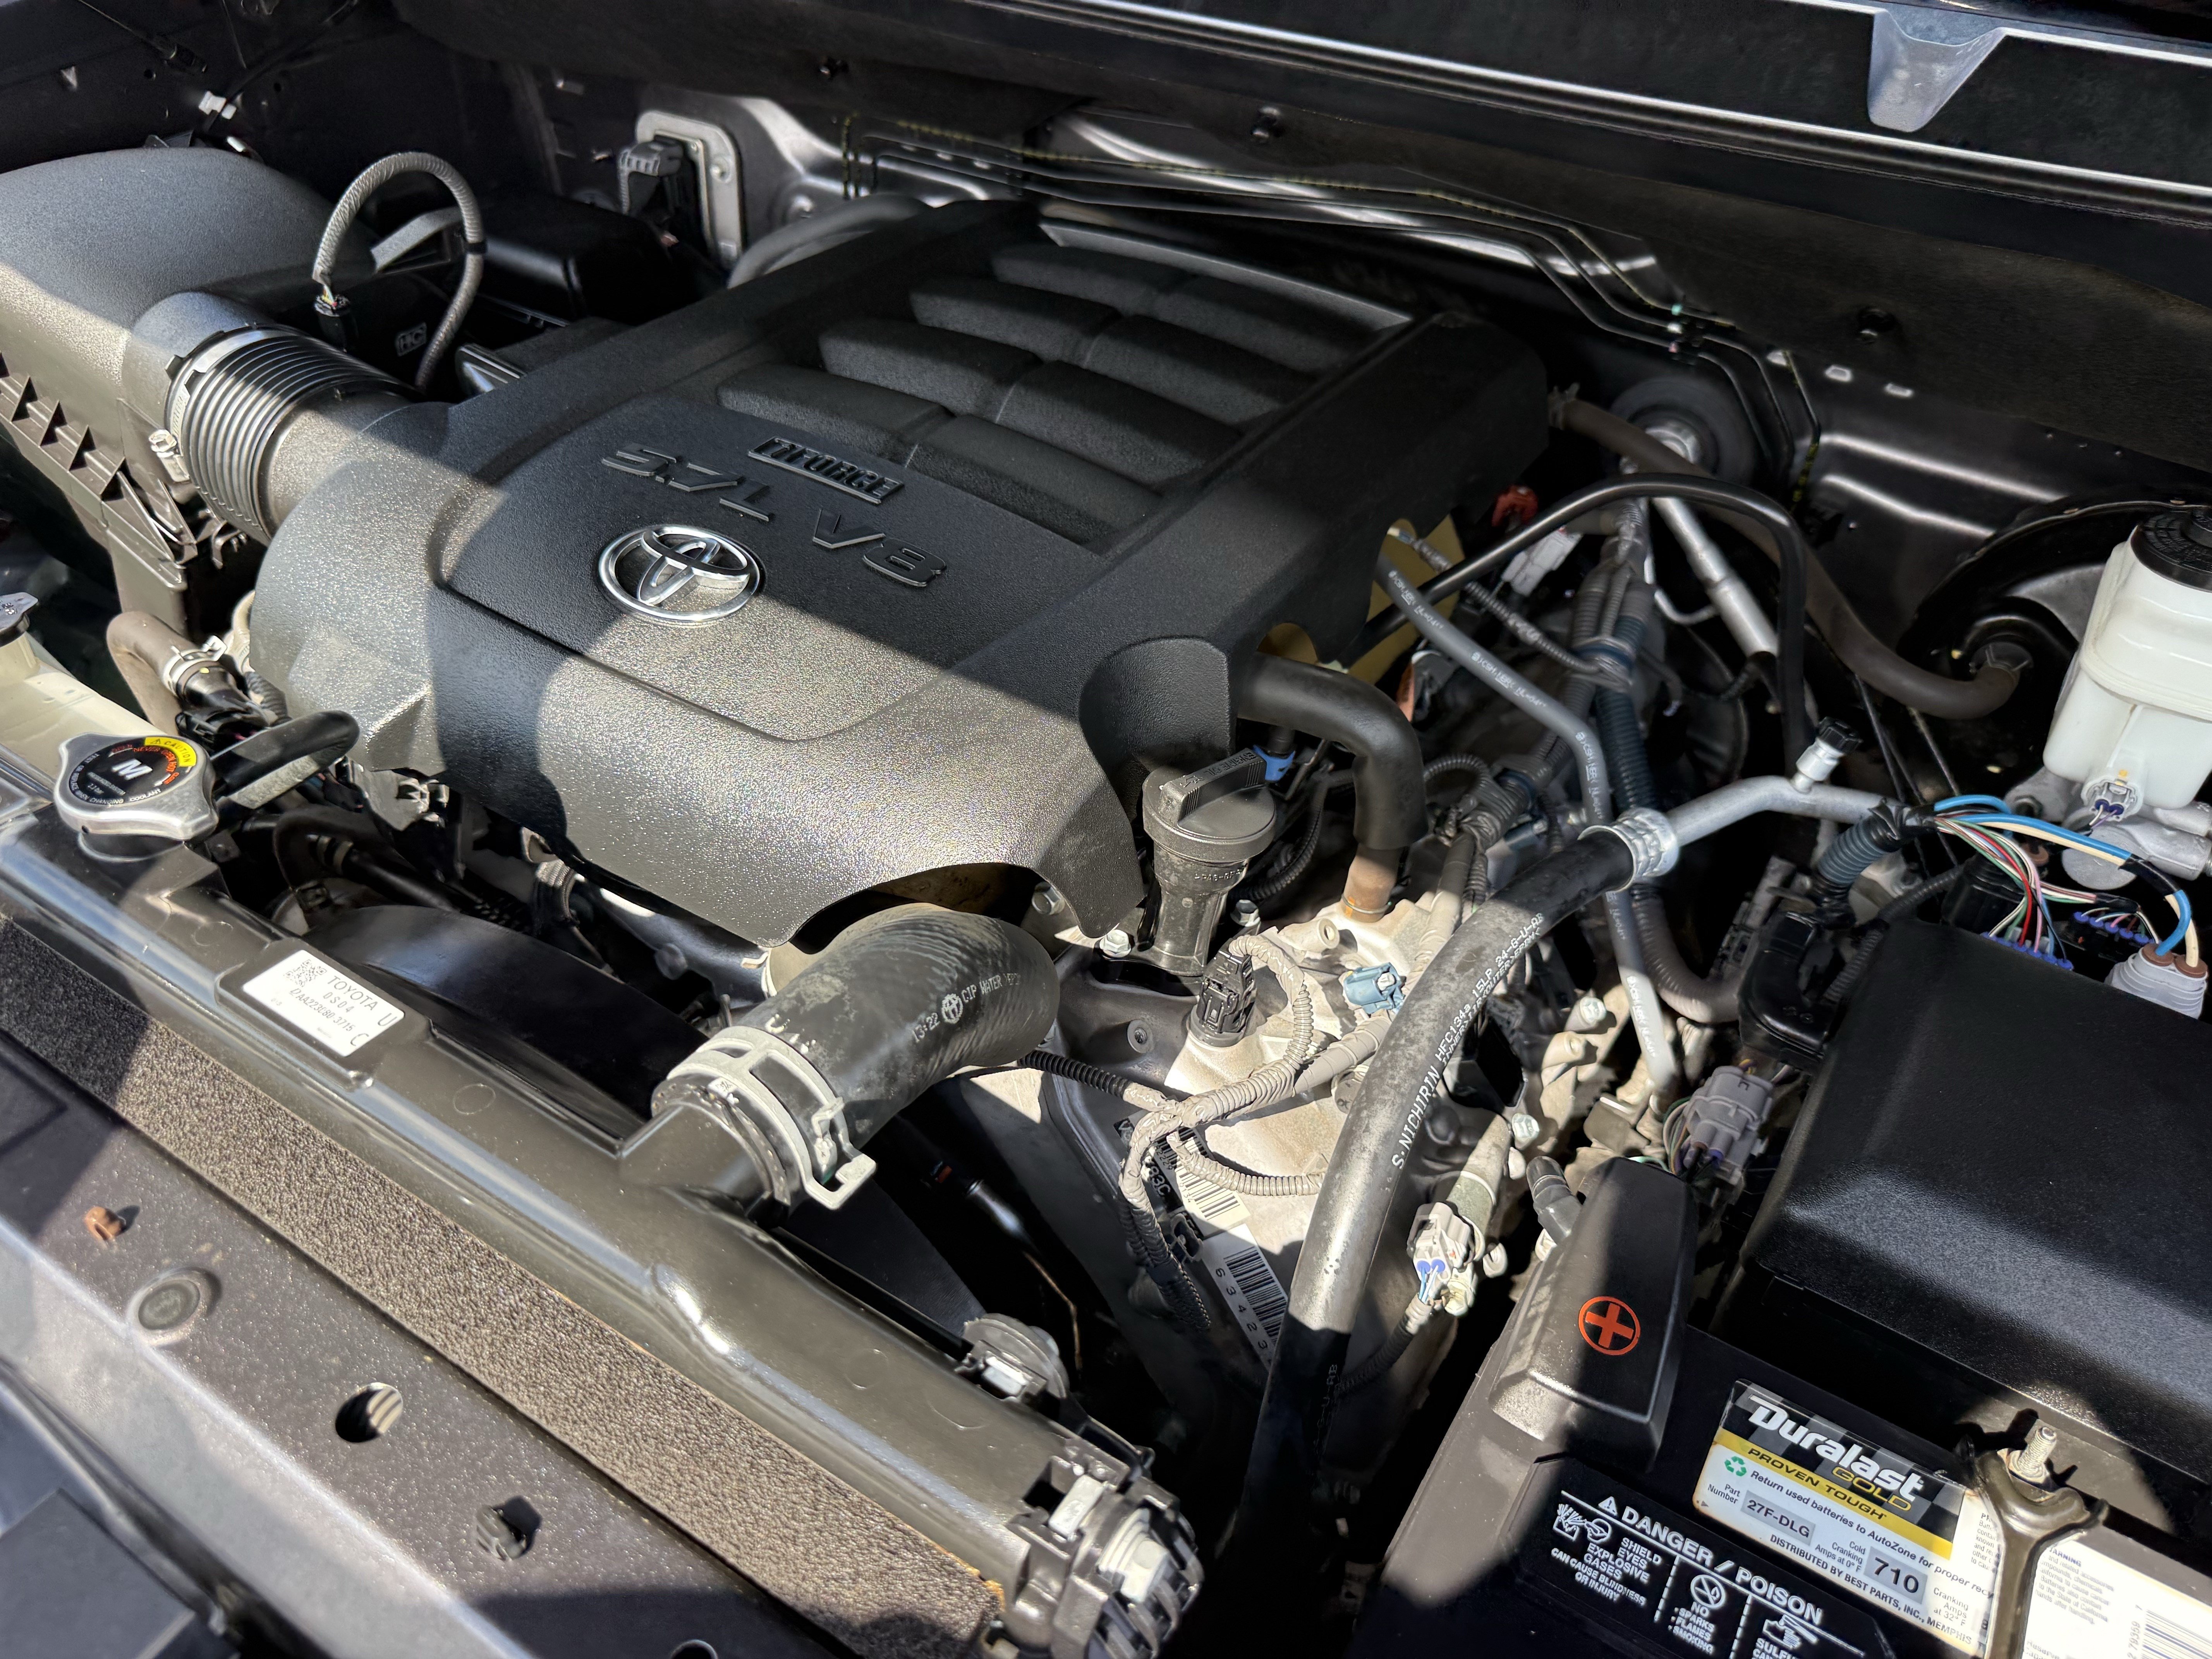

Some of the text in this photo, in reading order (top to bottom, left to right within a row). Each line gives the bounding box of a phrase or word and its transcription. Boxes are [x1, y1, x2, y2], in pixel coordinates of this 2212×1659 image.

[602, 444, 947, 587] 5.7L V8
[164, 740, 192, 763] CAUTION
[1203, 752, 1257, 776] ENGINE OIL
[129, 788, 161, 802] COOLANT
[327, 975, 378, 1011] TOYOTA
[1434, 1004, 1471, 1061] HFC134a
[1472, 968, 1493, 998] 15LP
[1748, 1394, 1924, 1501] Duralast
[1707, 1484, 1739, 1504] Number
[1724, 1484, 1741, 1498] Part
[1747, 1448, 1885, 1520] PROVEN TOUGH
[1832, 1466, 1912, 1511] GOLD
[1747, 1499, 1810, 1538] 27F-DLG
[1750, 1470, 1784, 1492] Return
[1785, 1488, 1810, 1506] used
[1811, 1499, 1854, 1528] batteries
[1856, 1523, 1866, 1535] to
[1867, 1530, 1917, 1560] AutoZone
[1918, 1555, 1934, 1569] for
[1934, 1566, 1970, 1588] proper
[1621, 1537, 1663, 1566] SHIELD
[1831, 1541, 1863, 1565] Cranking
[1849, 1541, 1867, 1555] Cold
[1974, 1543, 1985, 1552] and
[1976, 1534, 1994, 1548] known
[1583, 1553, 1623, 1580] GASES
[1587, 1542, 1651, 1584] EXPLOSIVE
[1617, 1547, 1648, 1570] EYES
[1621, 1506, 1715, 1567] DANGER
[1735, 1566, 1823, 1626] POISON
[1814, 1544, 1837, 1561] Amps
[1837, 1555, 1845, 1564] at
[1856, 1565, 1862, 1573] F
[1971, 1556, 1977, 1564] to
[1972, 1550, 1987, 1561] other
[1551, 1547, 1648, 1607] CAN CAUSE BLINDNESS
[1874, 1556, 1920, 1594] 710
[2040, 1560, 2072, 1580] ompounds,
[2040, 1568, 2063, 1583] alifornia
[2071, 1583, 2089, 1596] cause
[1575, 1571, 1621, 1602] OR INJURY
[1770, 1534, 1829, 1570] DISTRIBUTED
[1829, 1565, 1843, 1578] BY
[1844, 1570, 1869, 1591] BEST
[1870, 1587, 1901, 1611] PARTS,
[1903, 1604, 1925, 1623] INC.,
[1927, 1616, 1972, 1645] MEMPHIS
[1933, 1587, 1969, 1611] Cranking
[2040, 1574, 2066, 1592] Batteries
[2066, 1589, 2079, 1599] also
[2046, 1586, 2056, 1595] the
[2056, 1591, 2072, 1604] State
[1690, 1601, 1710, 1618] NO
[1933, 1607, 1942, 1616] at
[1943, 1602, 1967, 1619] Amps
[2054, 1599, 2067, 1610] after
[1675, 1616, 1712, 1642] FLAMES
[1678, 1607, 1716, 1633] SPARKS
[1672, 1625, 1715, 1656] SMOKING
